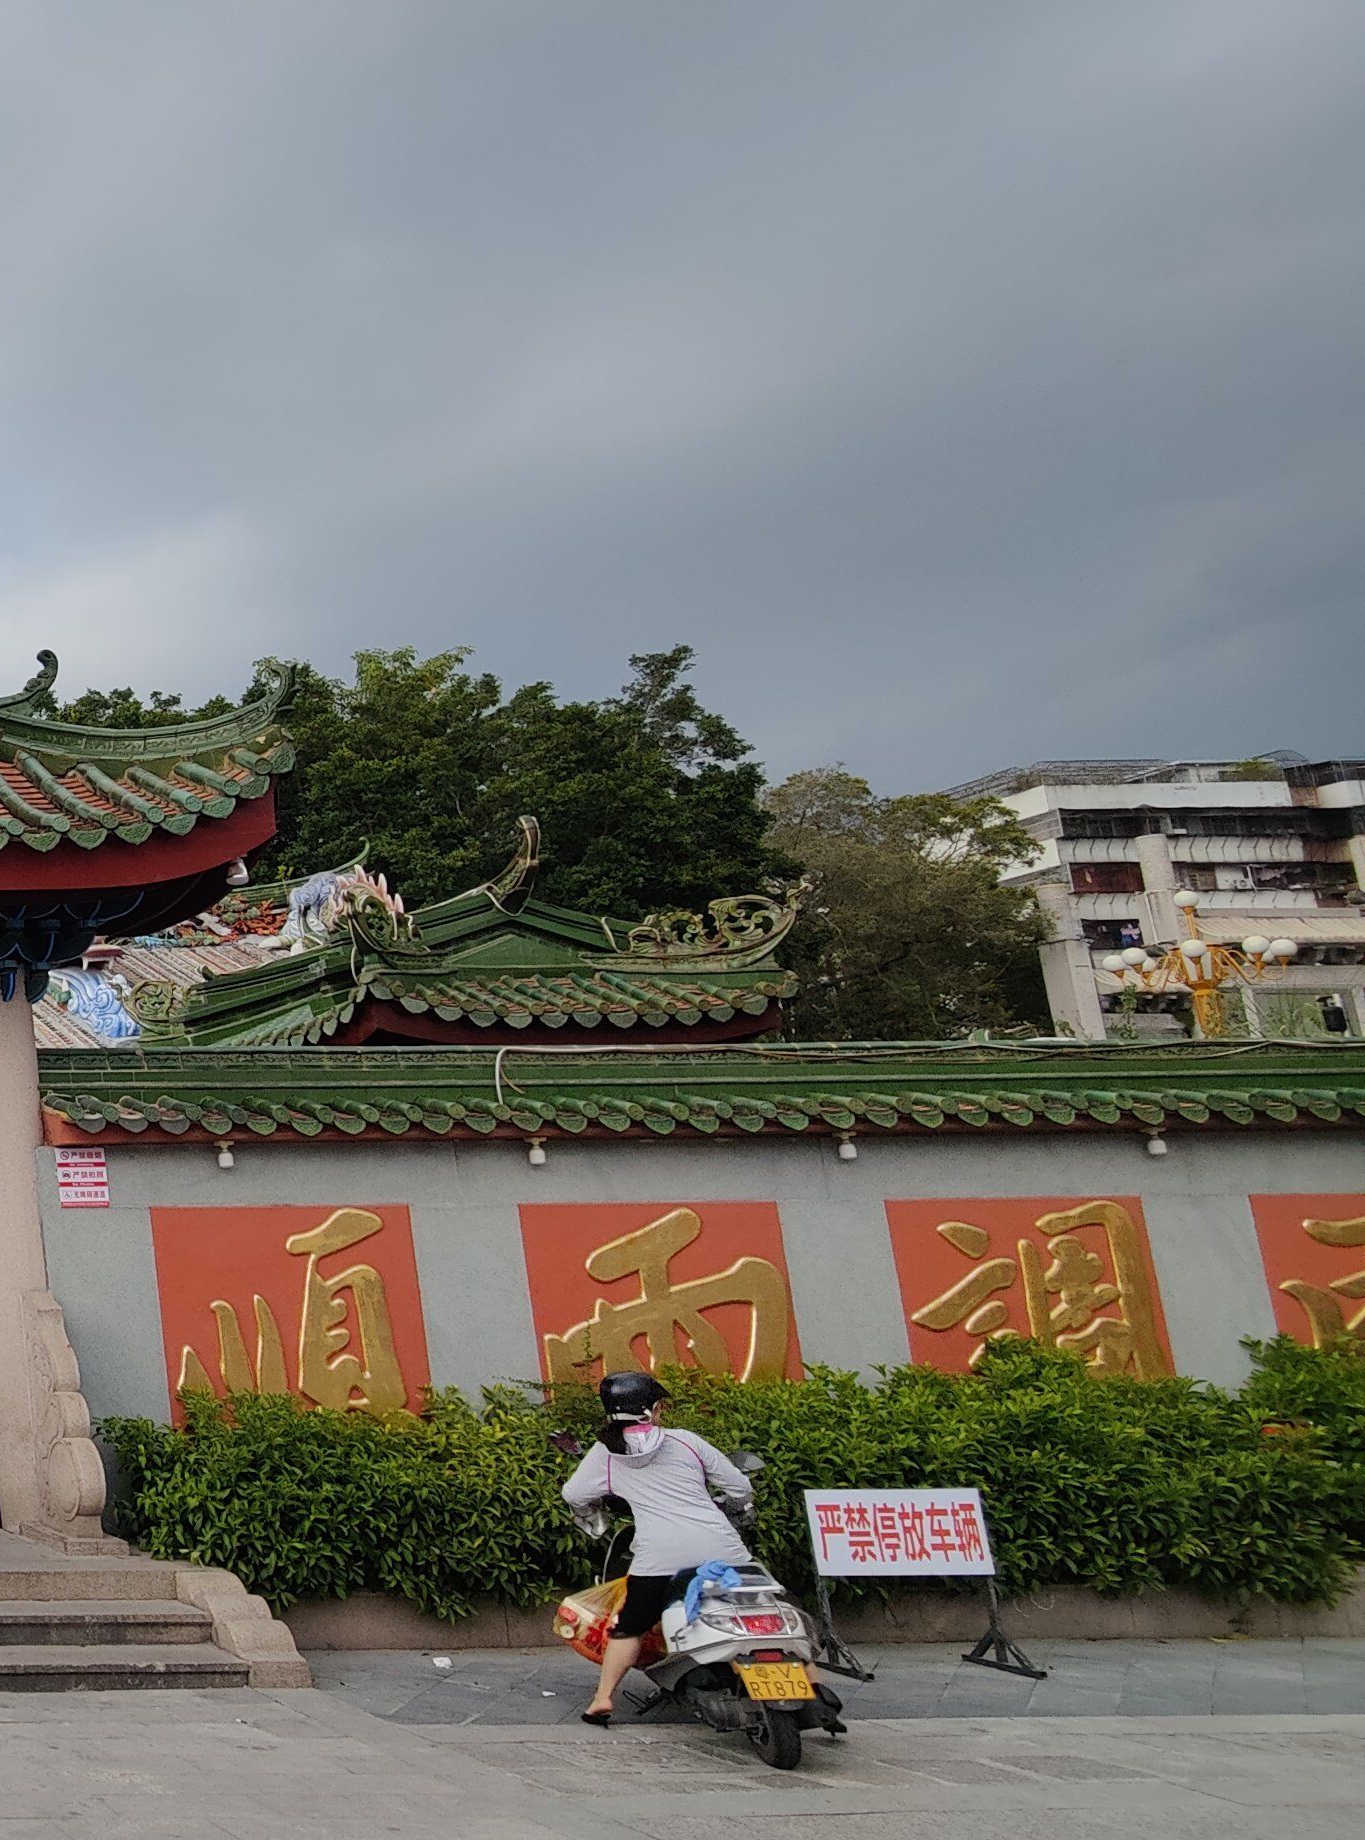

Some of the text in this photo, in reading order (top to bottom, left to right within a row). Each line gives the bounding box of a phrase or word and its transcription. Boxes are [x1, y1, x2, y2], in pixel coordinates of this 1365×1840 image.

[814, 1502, 985, 1563] 严禁停放车辆
[749, 1680, 808, 1698] RT879
